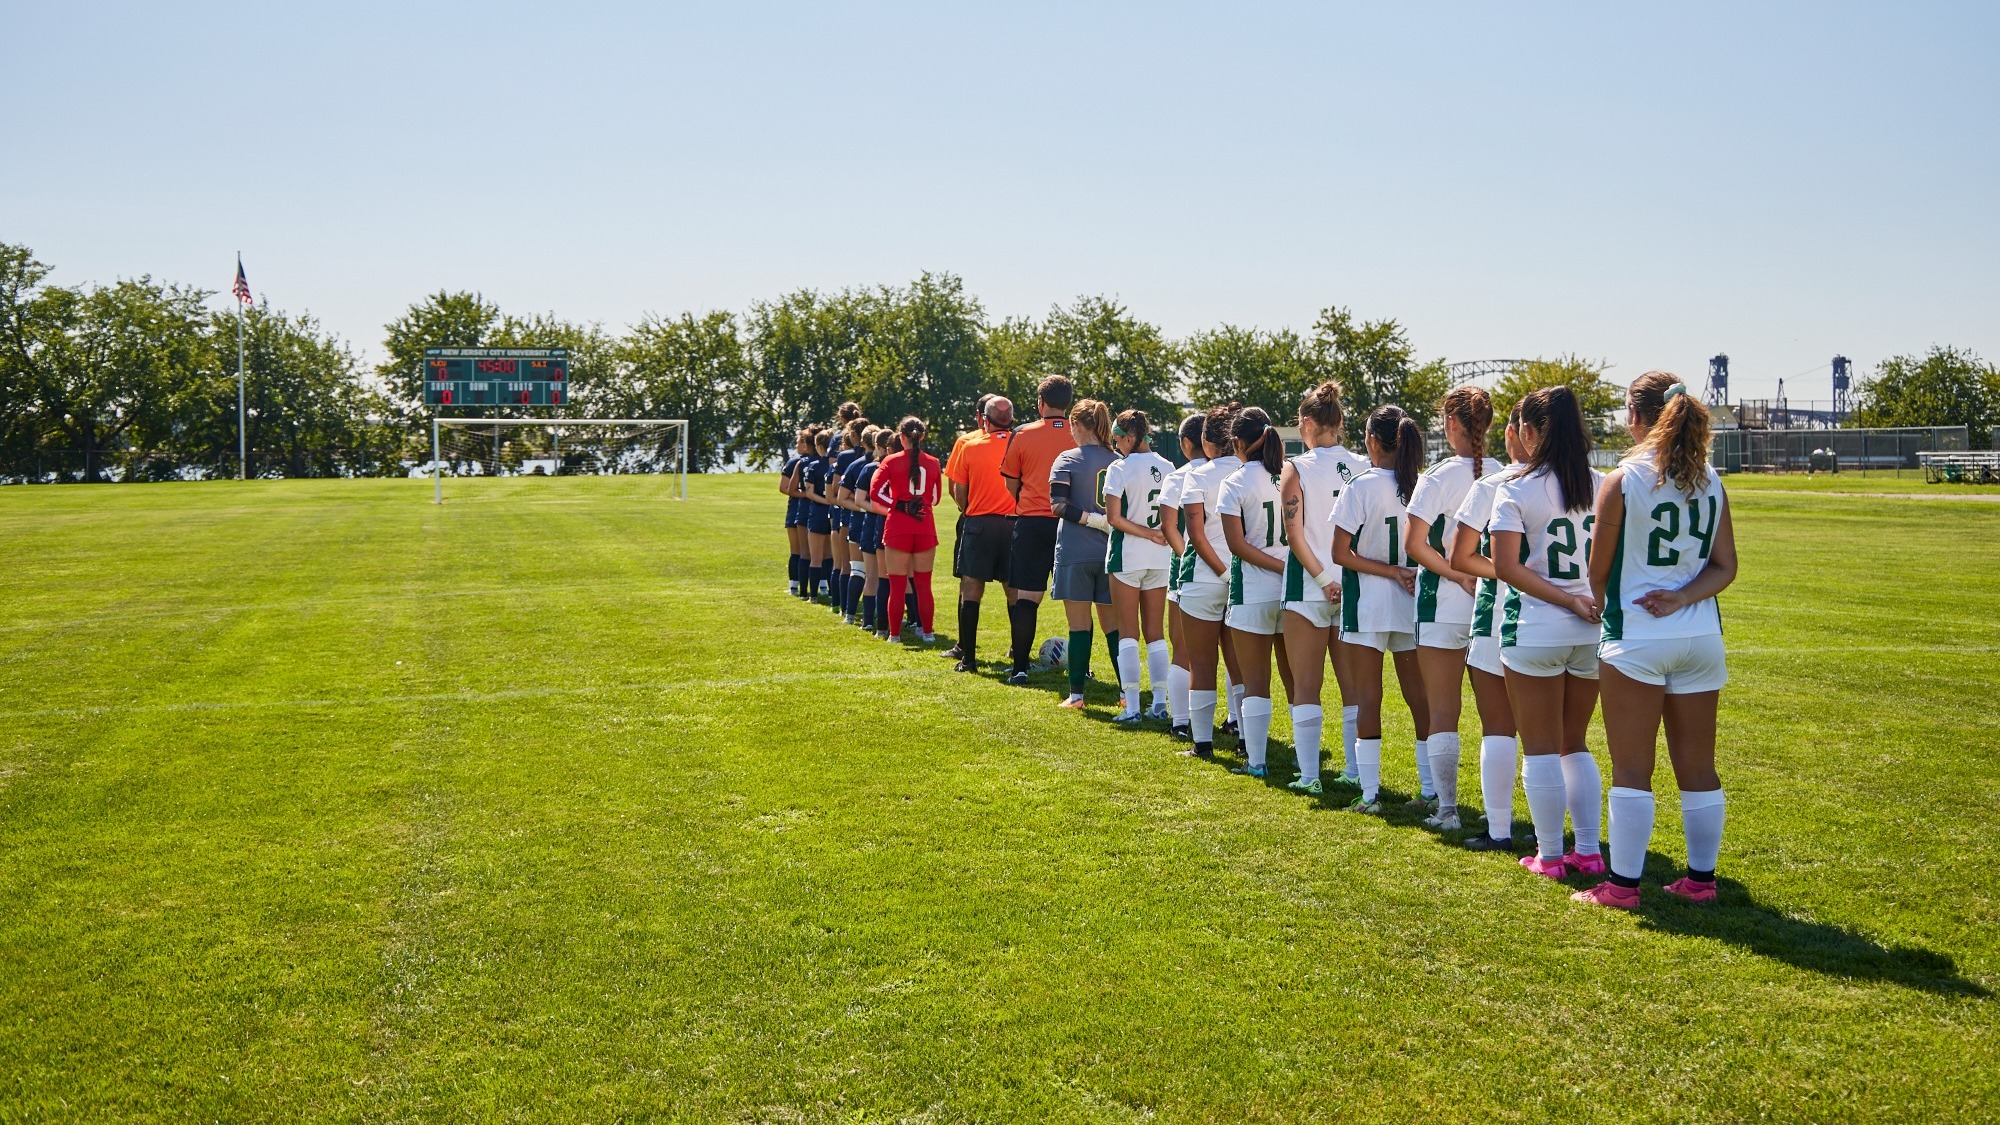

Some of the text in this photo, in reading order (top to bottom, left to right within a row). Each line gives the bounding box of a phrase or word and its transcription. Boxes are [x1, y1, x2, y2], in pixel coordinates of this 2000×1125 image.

[478, 360, 516, 373] 45:00
[438, 367, 448, 381] 0
[554, 367, 563, 381] 0
[431, 382, 455, 391] SHOTS
[508, 382, 533, 391] SHOTS
[442, 390, 452, 405] 0
[521, 390, 530, 404] 0
[552, 390, 561, 404] 0
[1146, 489, 1161, 528] 3
[1263, 501, 1288, 547] 1
[1646, 495, 1717, 566] 24
